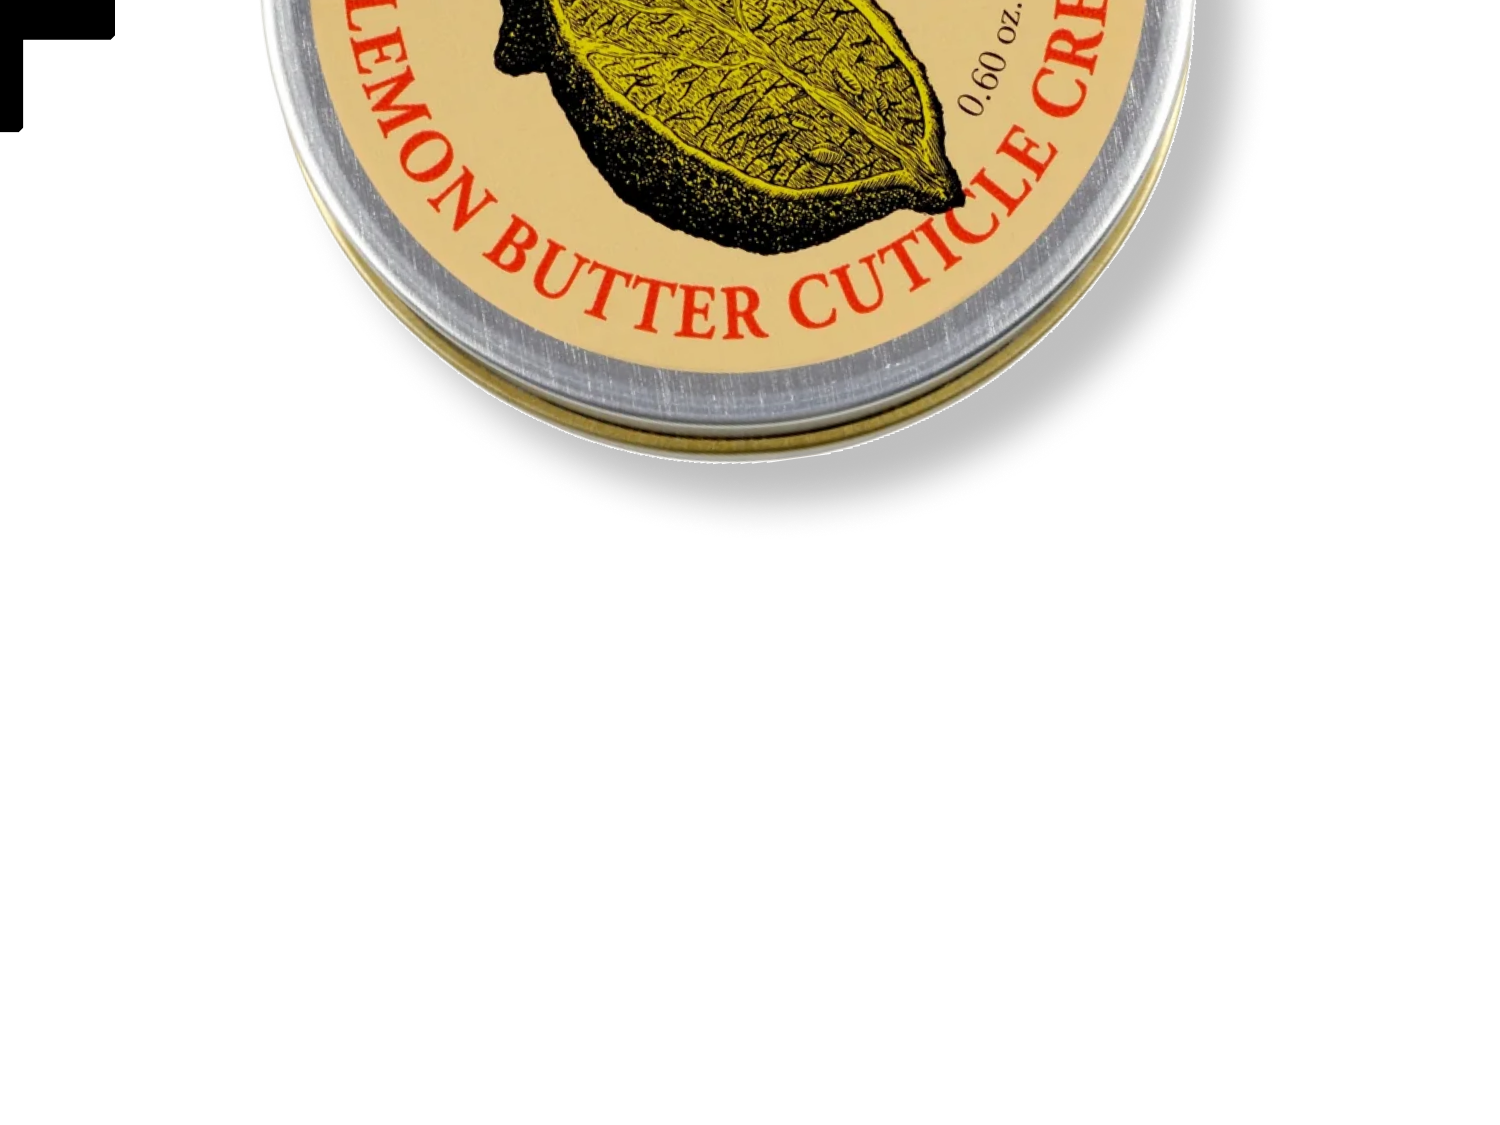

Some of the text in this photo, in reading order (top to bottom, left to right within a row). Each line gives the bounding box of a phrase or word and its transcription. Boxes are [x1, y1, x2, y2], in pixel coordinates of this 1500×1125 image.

[957, 50, 1007, 117] 0.60
[482, 216, 769, 340] BUTTER
[787, 127, 1058, 329] CUTICLE
